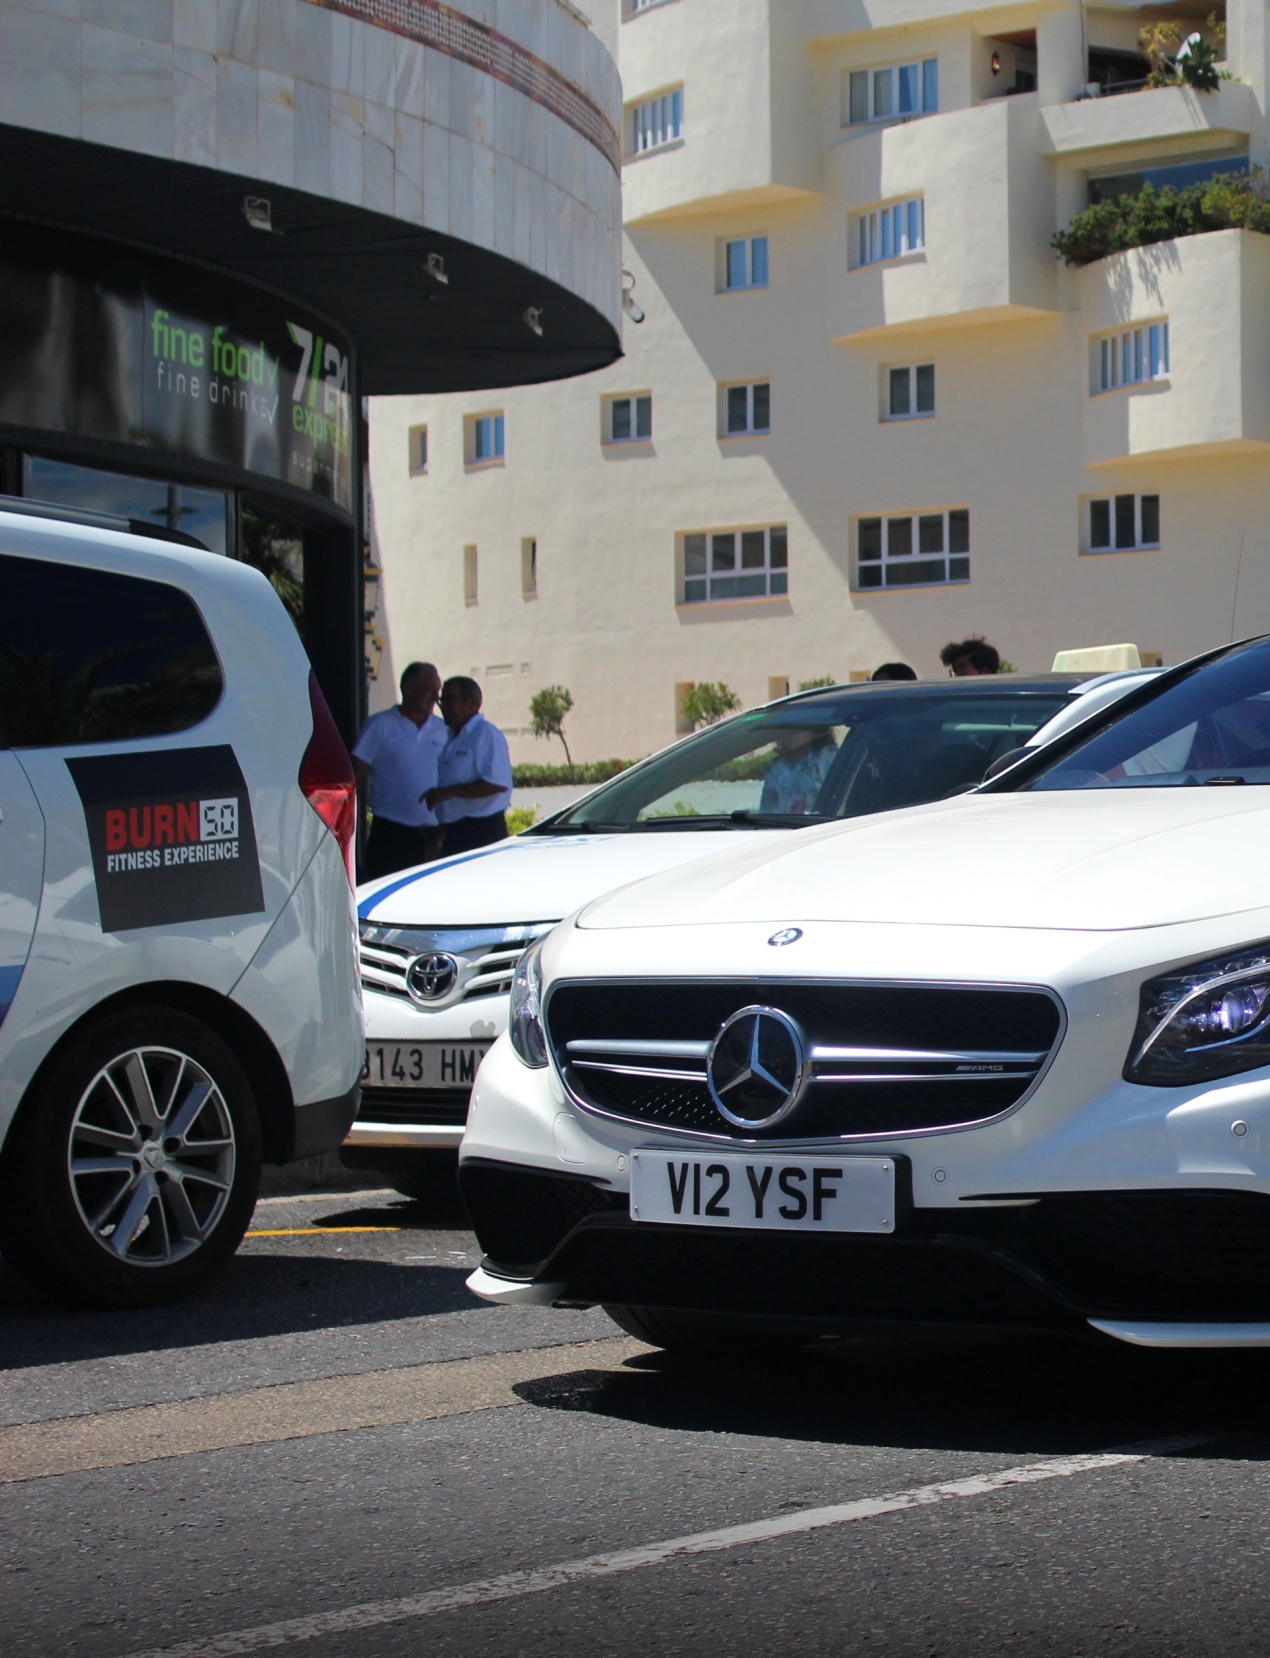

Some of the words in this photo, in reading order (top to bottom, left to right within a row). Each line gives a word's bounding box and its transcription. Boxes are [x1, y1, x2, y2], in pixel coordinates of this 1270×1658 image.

[151, 309, 204, 368] fine
[212, 326, 265, 386] food
[157, 361, 200, 398] fine
[209, 376, 267, 419] drinks
[105, 801, 198, 851] BURN
[203, 803, 235, 837] 50
[107, 849, 161, 873] FITNESS
[164, 841, 239, 866] EXPERIENCE
[441, 1048, 485, 1082] HM
[667, 1162, 730, 1217] V12
[746, 1165, 843, 1221] YSF
